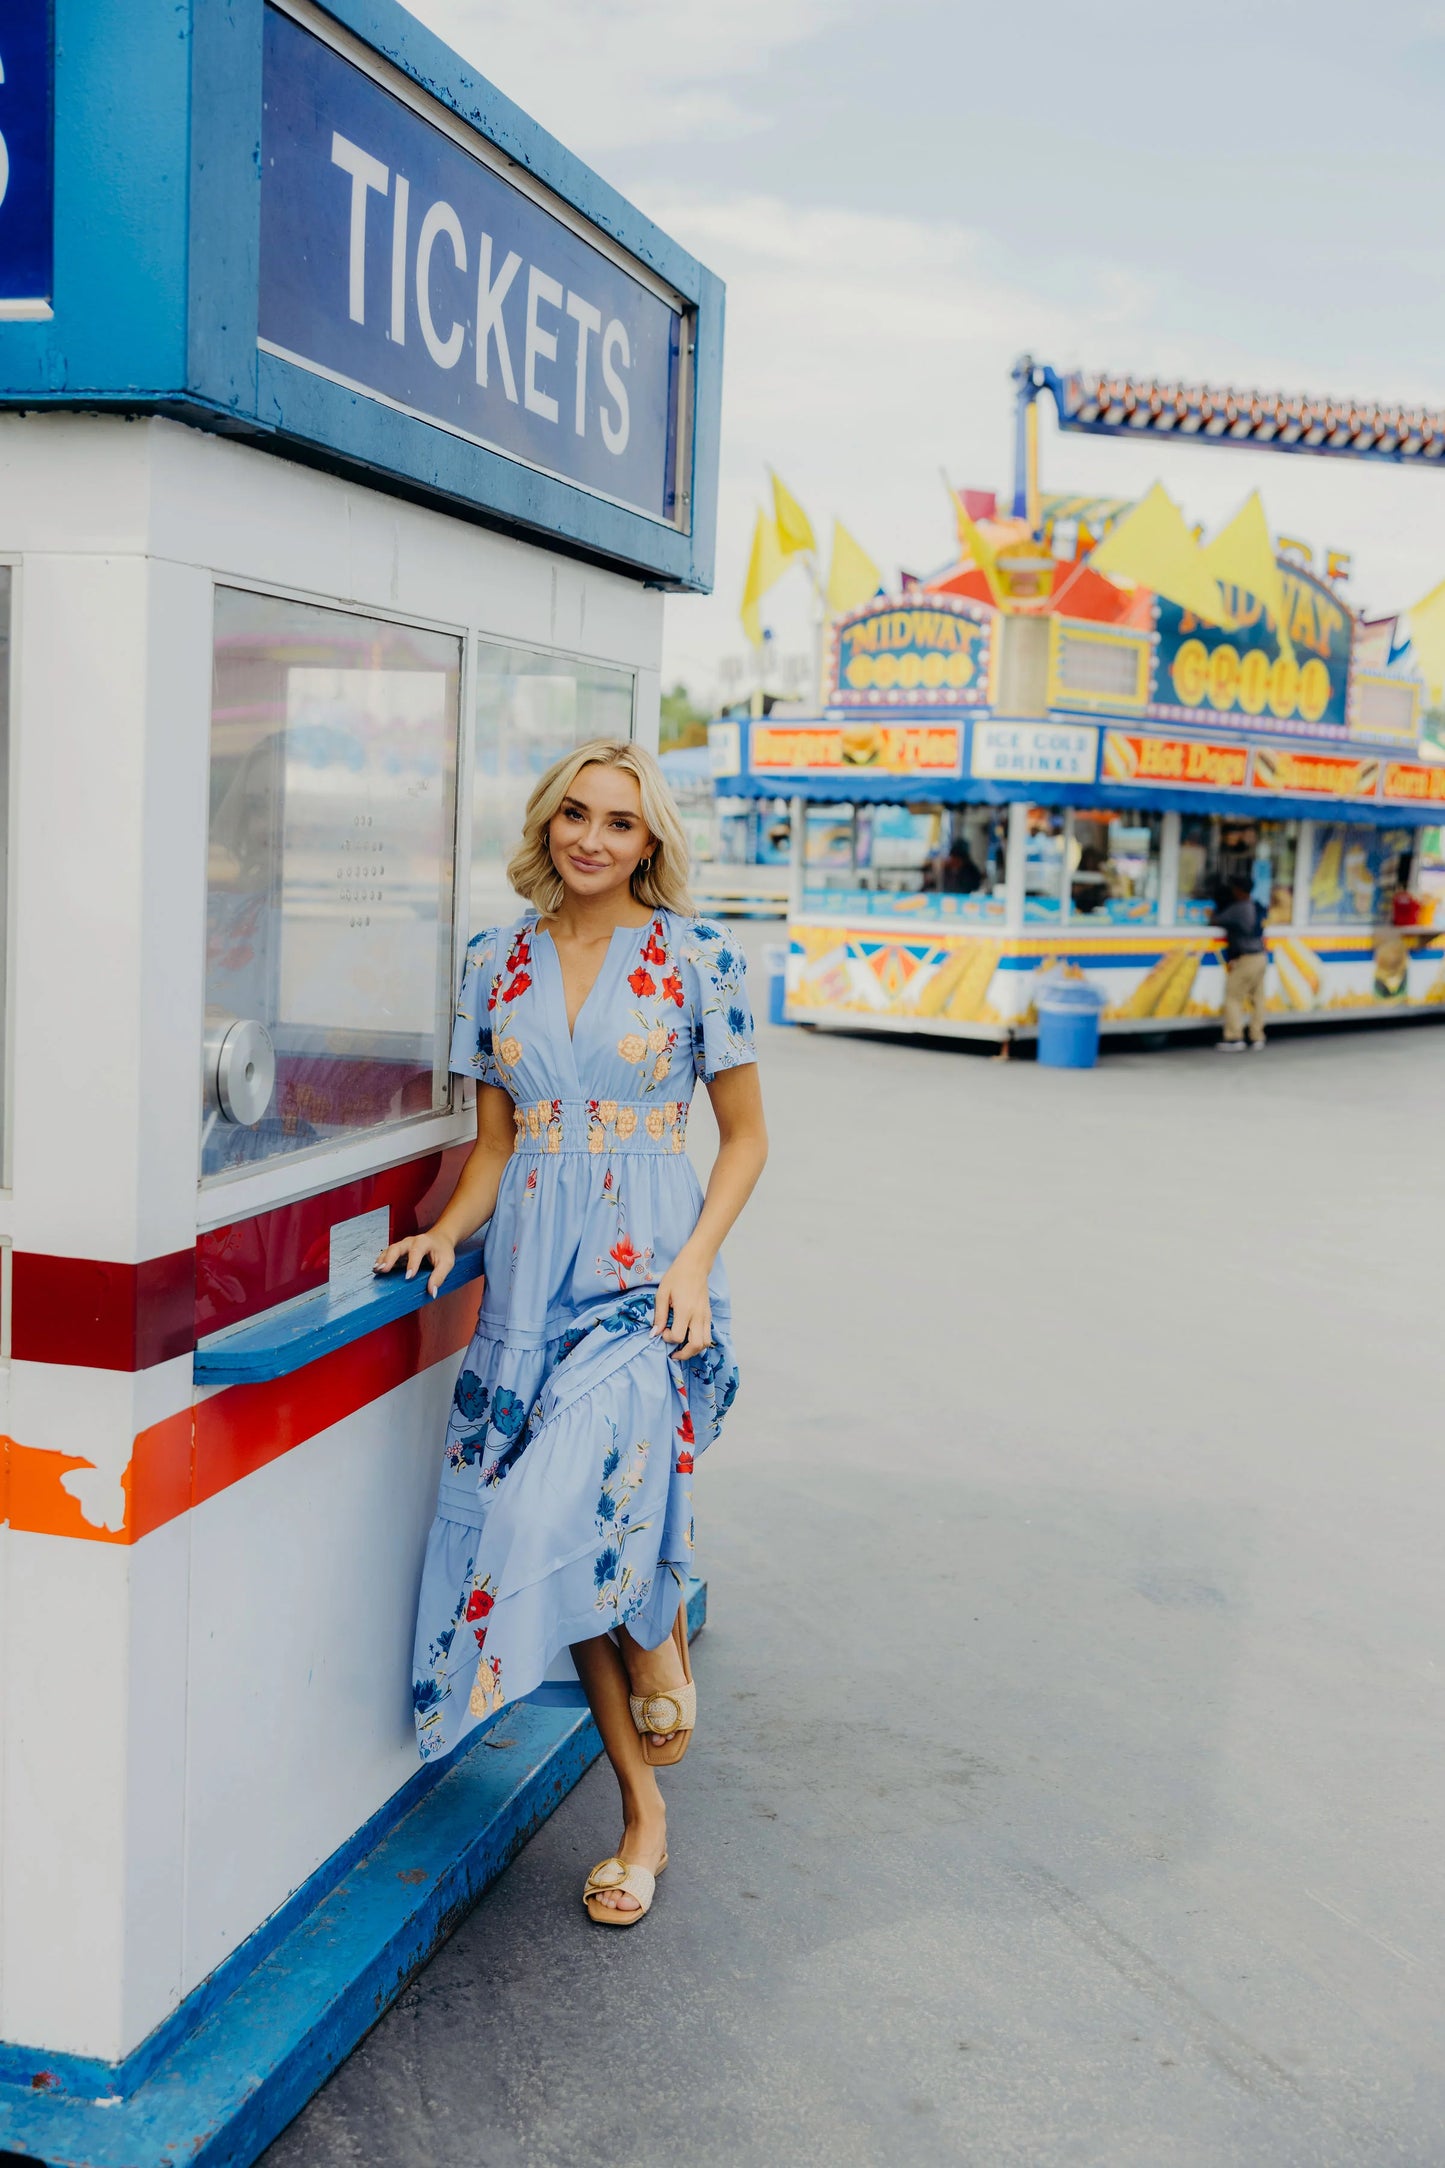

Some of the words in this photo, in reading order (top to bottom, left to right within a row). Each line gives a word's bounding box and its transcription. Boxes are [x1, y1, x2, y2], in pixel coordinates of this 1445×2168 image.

[331, 131, 631, 456] TICKETS
[842, 611, 980, 656] MIDWAY
[1175, 642, 1327, 718] GRILL
